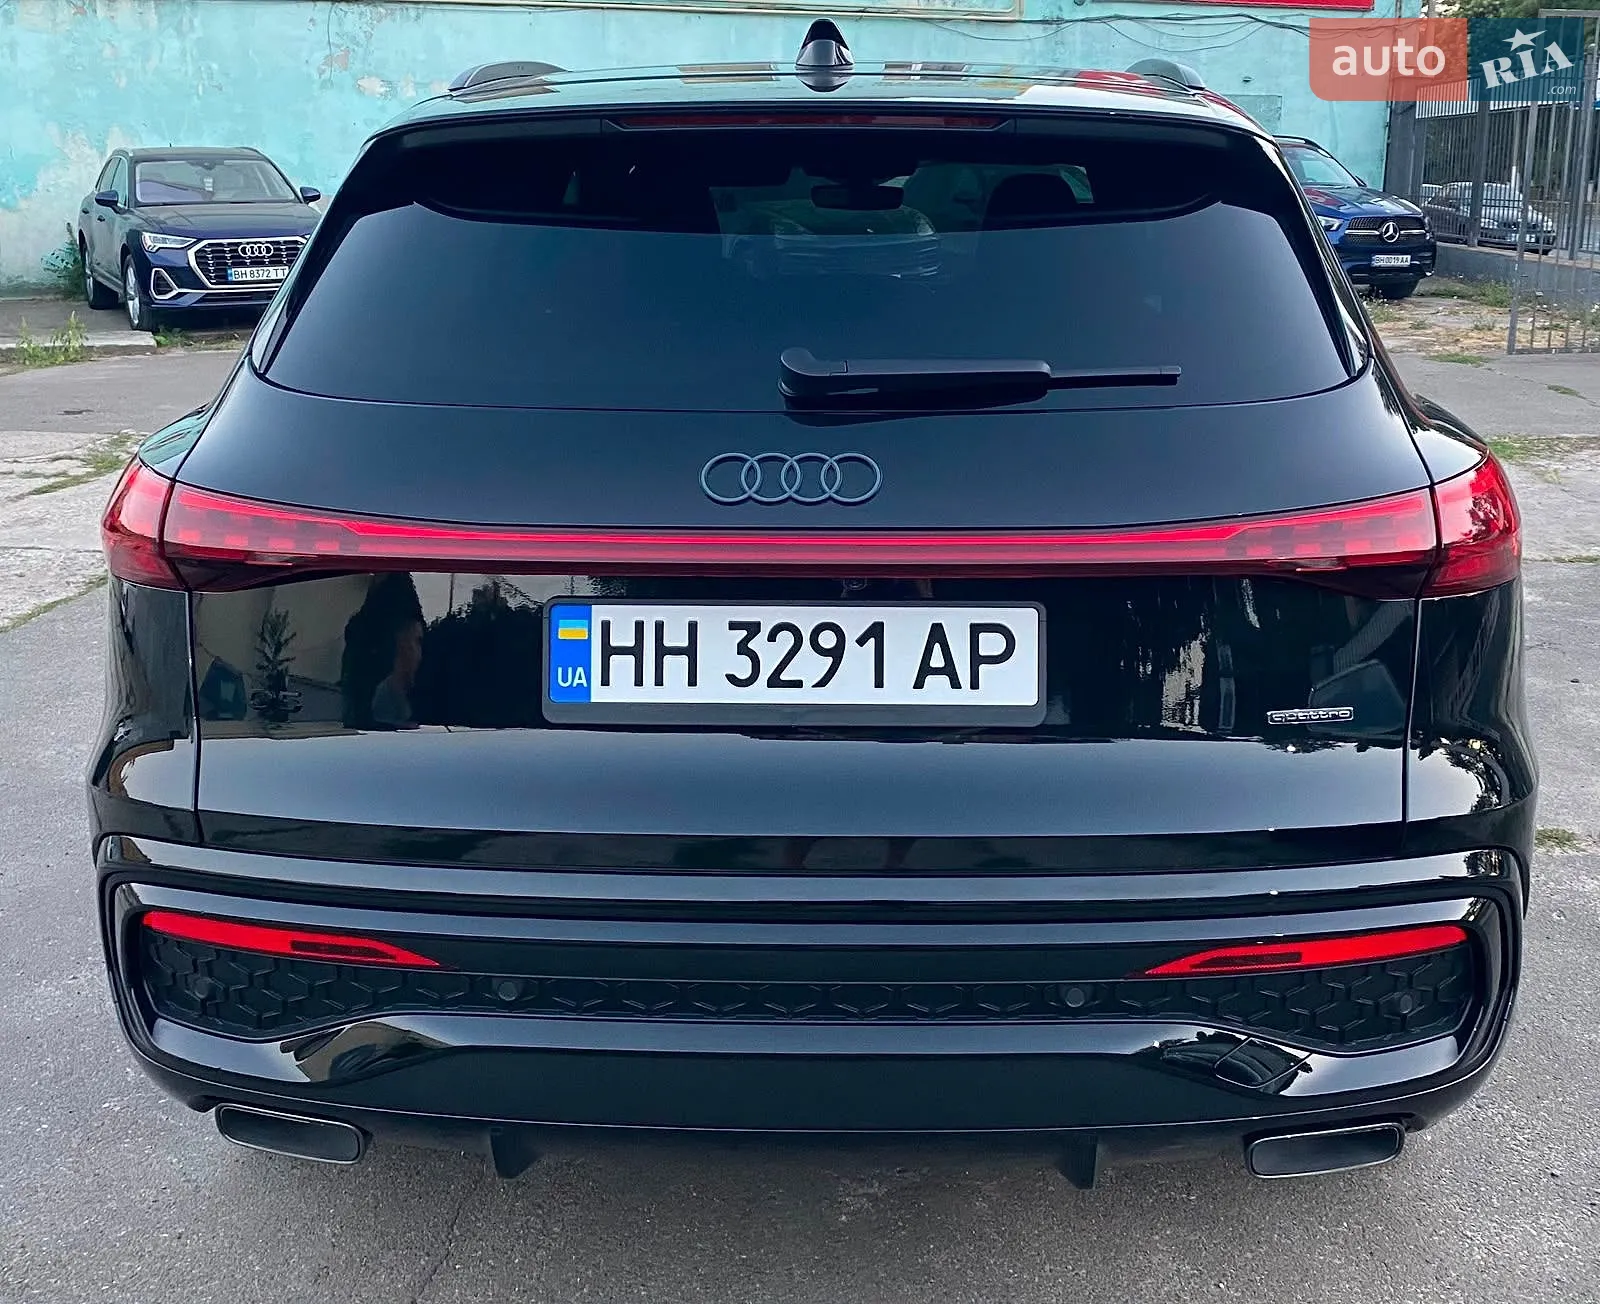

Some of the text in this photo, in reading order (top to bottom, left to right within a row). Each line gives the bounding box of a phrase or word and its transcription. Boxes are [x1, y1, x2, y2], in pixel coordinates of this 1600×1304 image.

[233, 268, 287, 279] BH 8372 TT
[600, 620, 1016, 690] HH 3291 AP
[557, 667, 588, 688] UA
[1272, 710, 1351, 723] quattro
